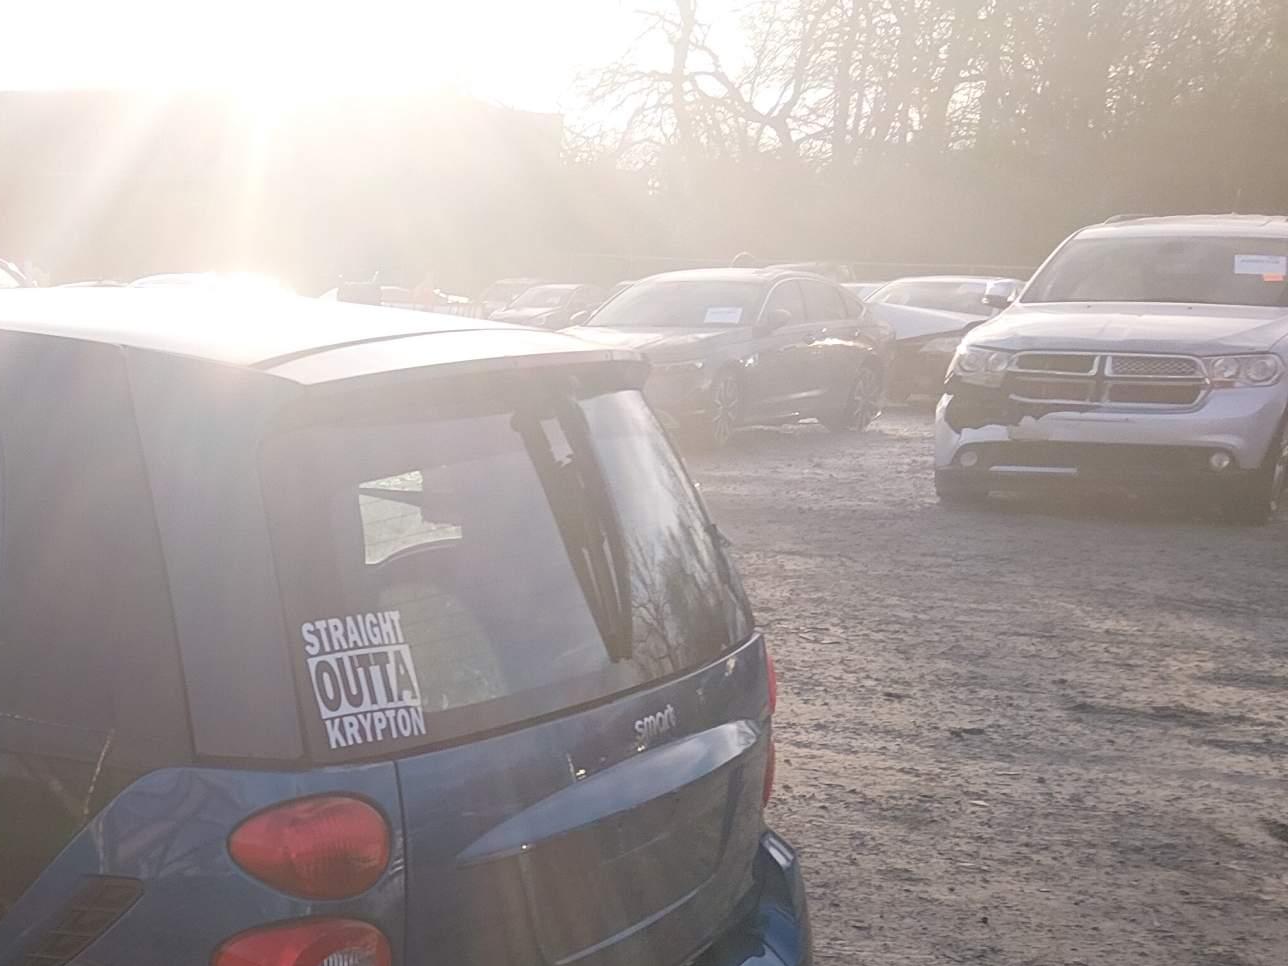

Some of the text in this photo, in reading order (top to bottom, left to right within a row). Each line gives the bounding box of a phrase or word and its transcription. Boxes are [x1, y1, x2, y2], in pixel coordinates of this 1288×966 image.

[302, 610, 405, 656] STRAIGHT
[314, 650, 419, 712] OUTTA
[325, 707, 427, 749] KRYPTON
[634, 704, 676, 738] smart
